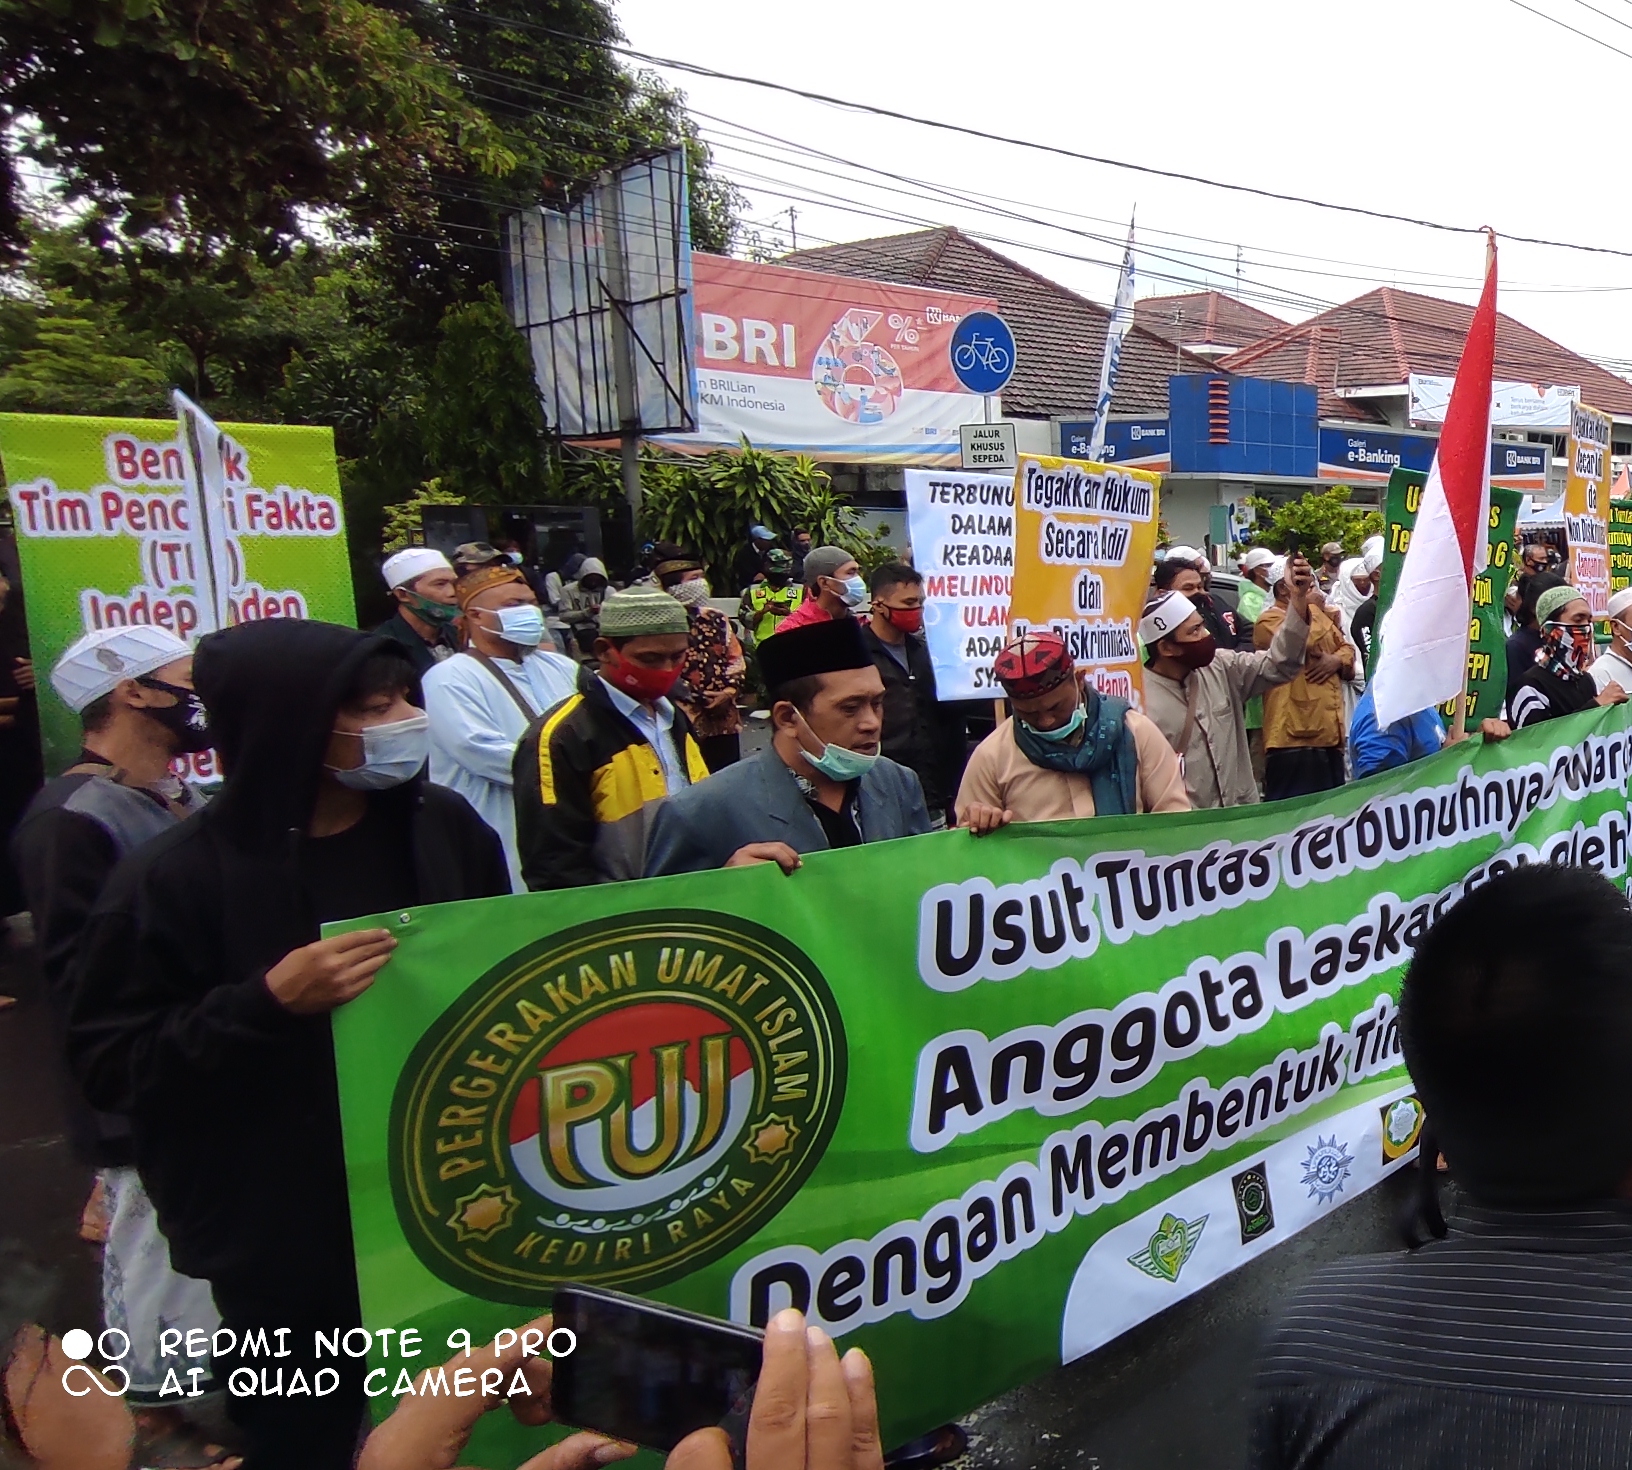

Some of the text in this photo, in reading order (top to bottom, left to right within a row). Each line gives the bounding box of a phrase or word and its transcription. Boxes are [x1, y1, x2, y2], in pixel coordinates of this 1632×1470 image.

[701, 312, 796, 369] BRI
[710, 380, 756, 395] BRILian
[727, 396, 786, 412] Indonesia
[970, 442, 1005, 451] KHUSUS
[973, 429, 1000, 439] JALUR
[1347, 438, 1367, 448] Galeri
[114, 438, 245, 481] Benk
[972, 454, 1004, 463] SEPEDA
[1071, 443, 1116, 456] e-Bang
[1347, 449, 1401, 467] e-Banking
[1517, 456, 1531, 465] BANK
[928, 481, 1014, 506] TERBUNU
[1026, 467, 1150, 517] Tegakkan Hukum
[19, 484, 337, 532] Tim Penci Fakta
[950, 513, 1012, 537] DALAM
[1044, 522, 1129, 561] Secara Adil
[1494, 541, 1510, 568] 6
[942, 545, 1013, 567] KEADAA
[1078, 574, 1102, 611] dan
[90, 589, 302, 641] Indepnden
[935, 872, 1091, 977] Usut
[1095, 841, 1277, 930] Tuntas
[1290, 772, 1544, 876] Terbunuhnya
[928, 964, 1264, 1135] Anggota
[436, 947, 809, 1181] PERGERAKAN UMAT ISLAM
[750, 1176, 1036, 1328] Dengan
[1050, 1034, 1345, 1217] Membentuk
[513, 1177, 756, 1267] KEDIRI RAYA
